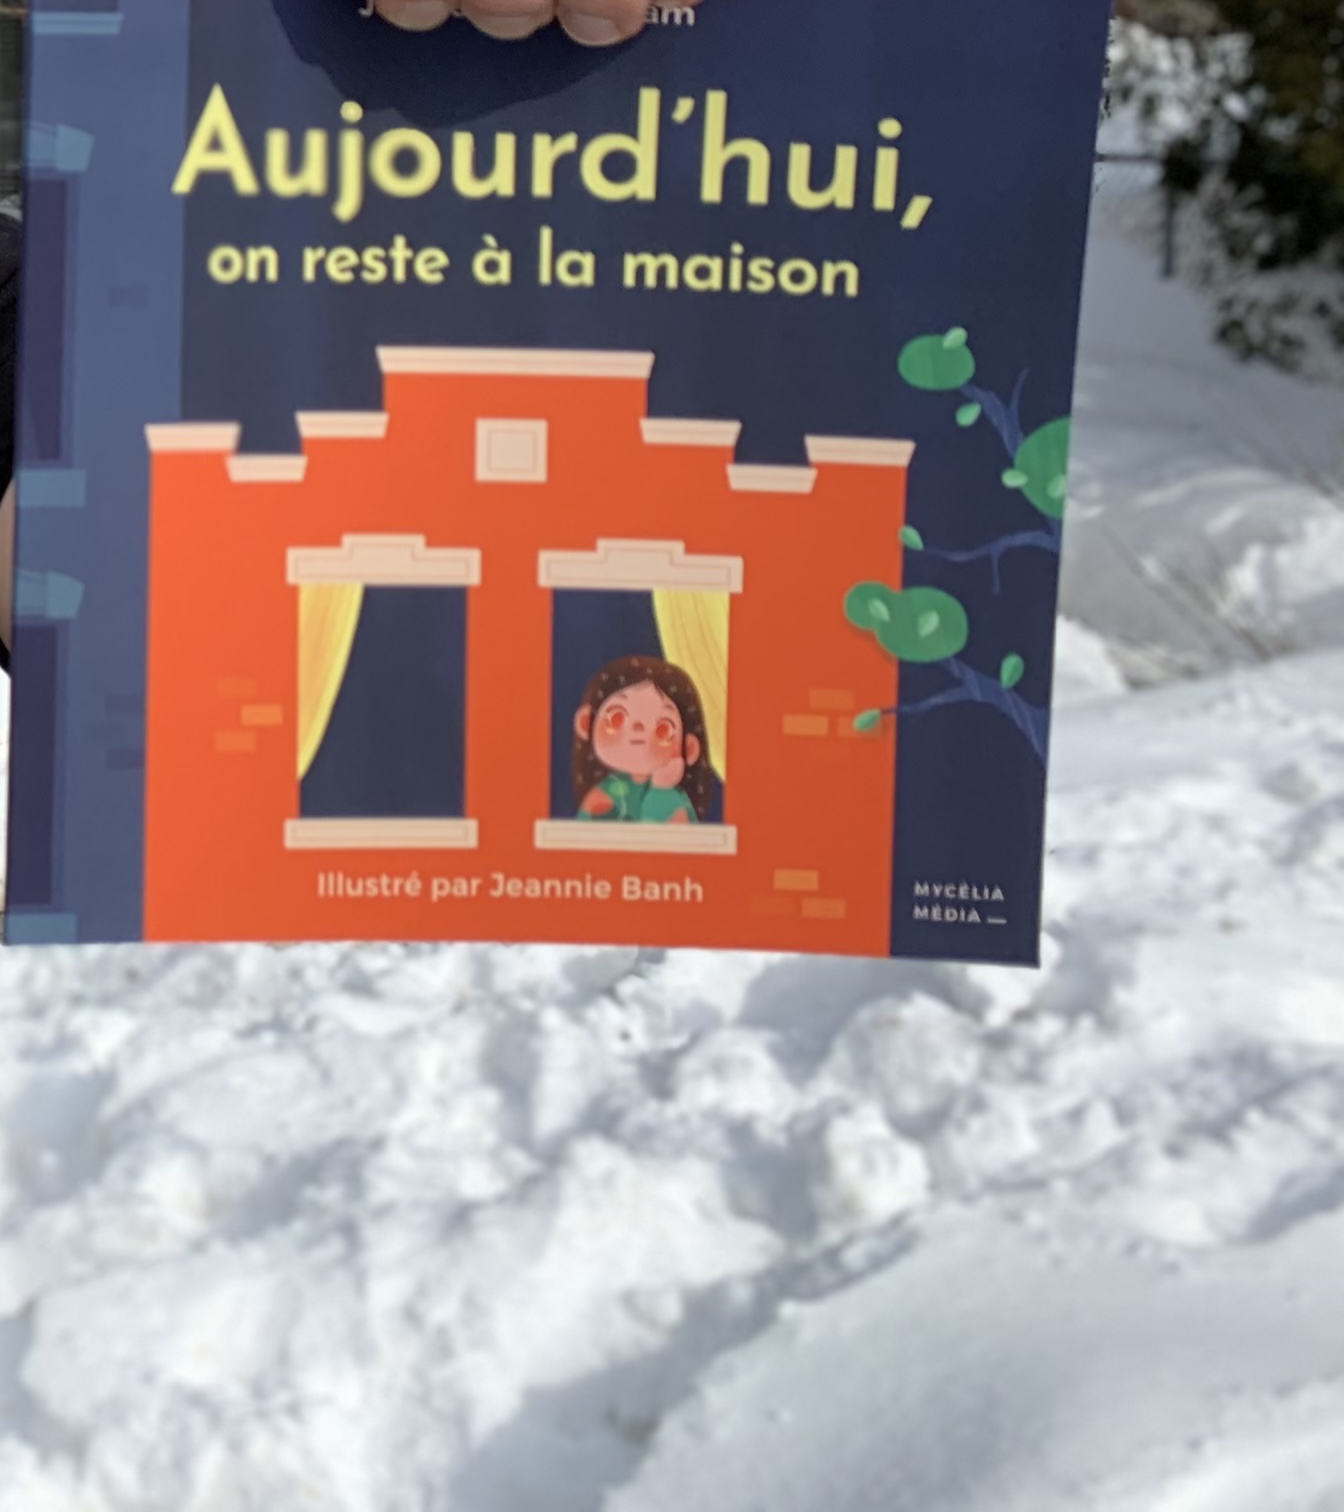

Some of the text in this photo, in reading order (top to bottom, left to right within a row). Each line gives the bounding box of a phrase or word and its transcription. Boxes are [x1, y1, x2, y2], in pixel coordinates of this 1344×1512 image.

[172, 83, 933, 229] Aujourd'hui,
[207, 225, 860, 298] on reste à la maison
[317, 870, 705, 903] Illustré par Jeannie Banh
[913, 879, 1005, 902] MYCÉLIA
[913, 902, 982, 924] MÉDIA
